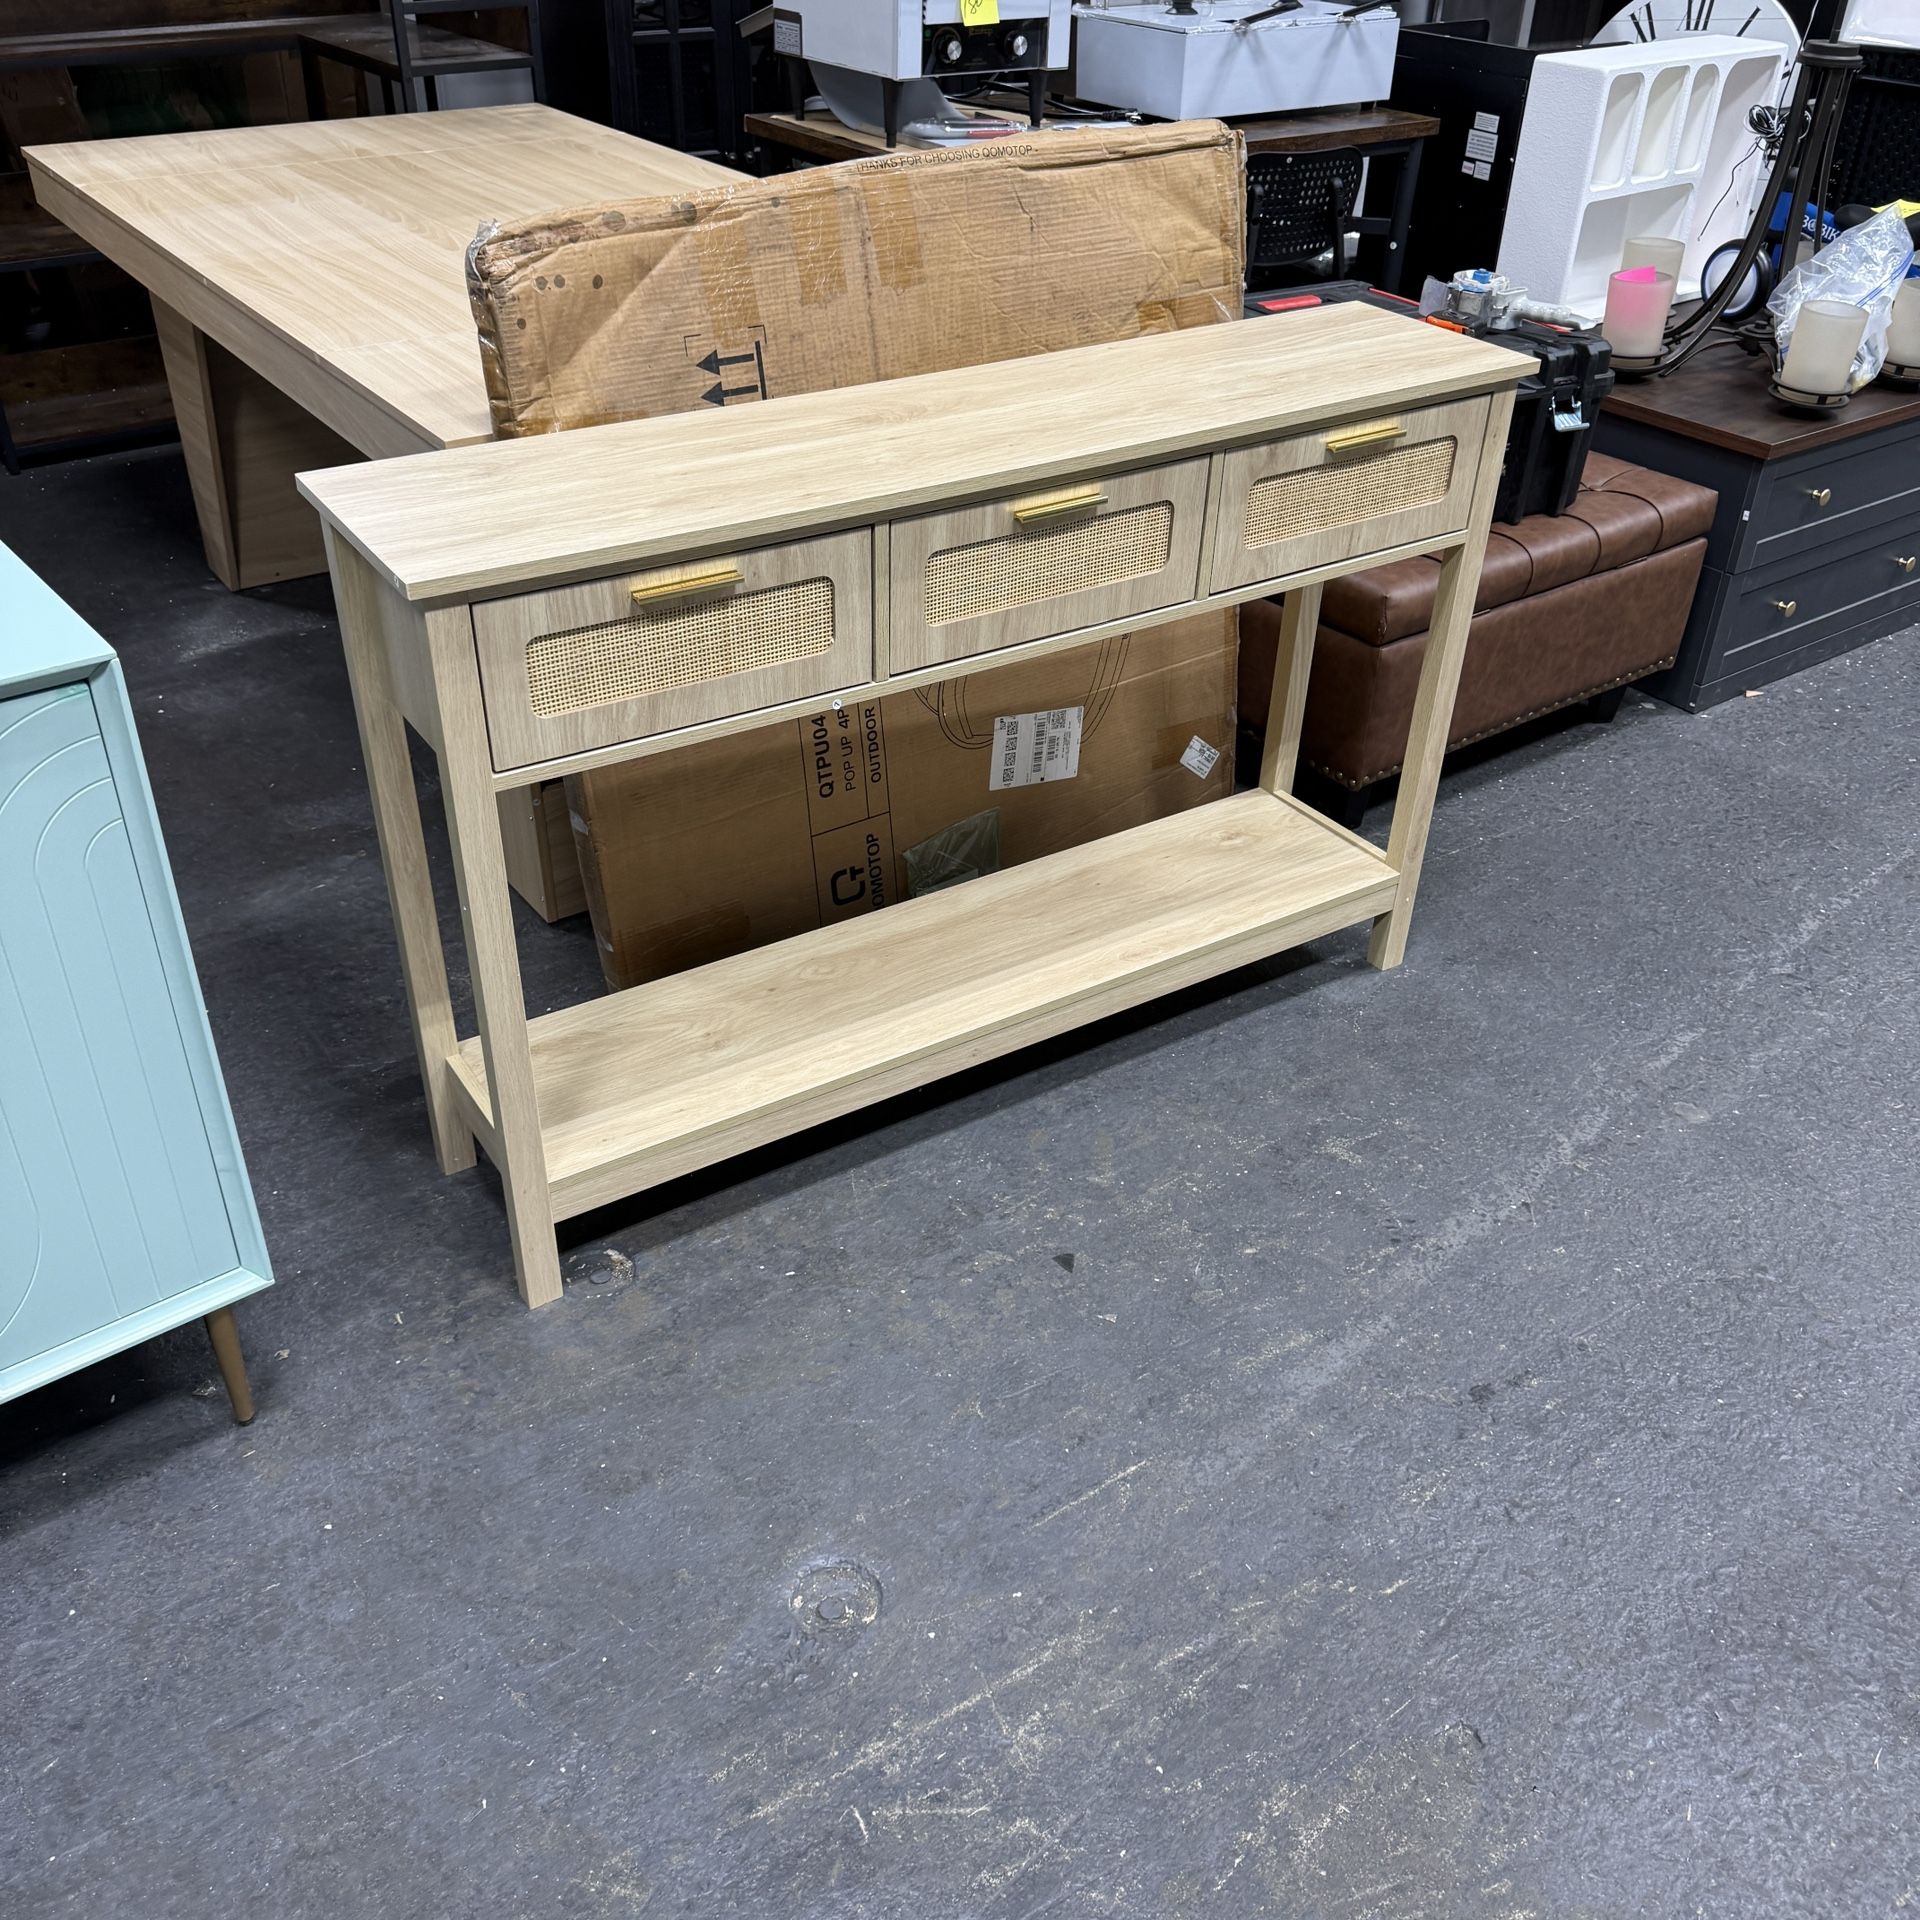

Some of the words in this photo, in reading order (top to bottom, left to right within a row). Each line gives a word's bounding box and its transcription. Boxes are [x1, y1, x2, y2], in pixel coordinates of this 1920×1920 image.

[899, 154, 922, 167] FOR
[925, 148, 980, 164] CHOOSING
[837, 709, 850, 729] 4P
[811, 714, 834, 798] QTPU04
[840, 736, 853, 757] UP
[864, 706, 882, 783] OUTDOOR
[843, 761, 856, 791] POP
[866, 833, 885, 908] OMOTOP
